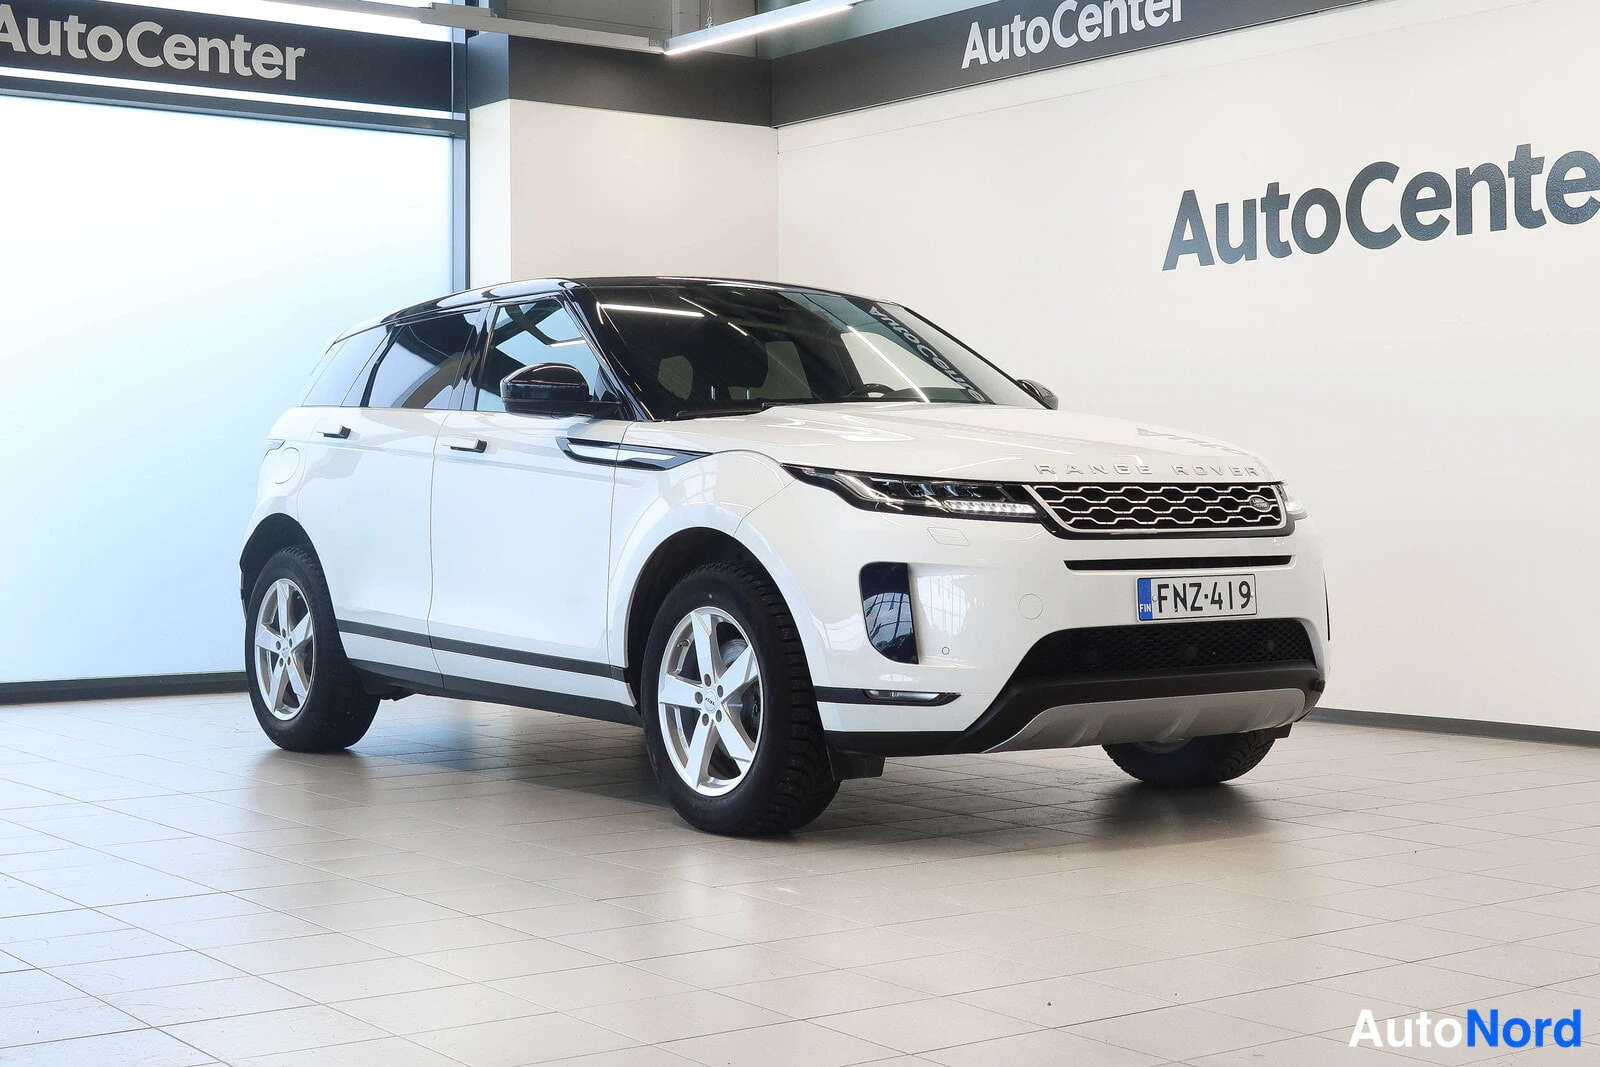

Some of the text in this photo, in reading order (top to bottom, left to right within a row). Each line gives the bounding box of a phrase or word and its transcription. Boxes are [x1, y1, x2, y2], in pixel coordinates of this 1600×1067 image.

[0, 3, 306, 81] AutoCenter
[1162, 143, 1600, 271] AutoCente
[1034, 464, 1259, 476] RANGE ROVER
[1139, 603, 1152, 613] FIN
[1157, 580, 1251, 613] FNZ-419
